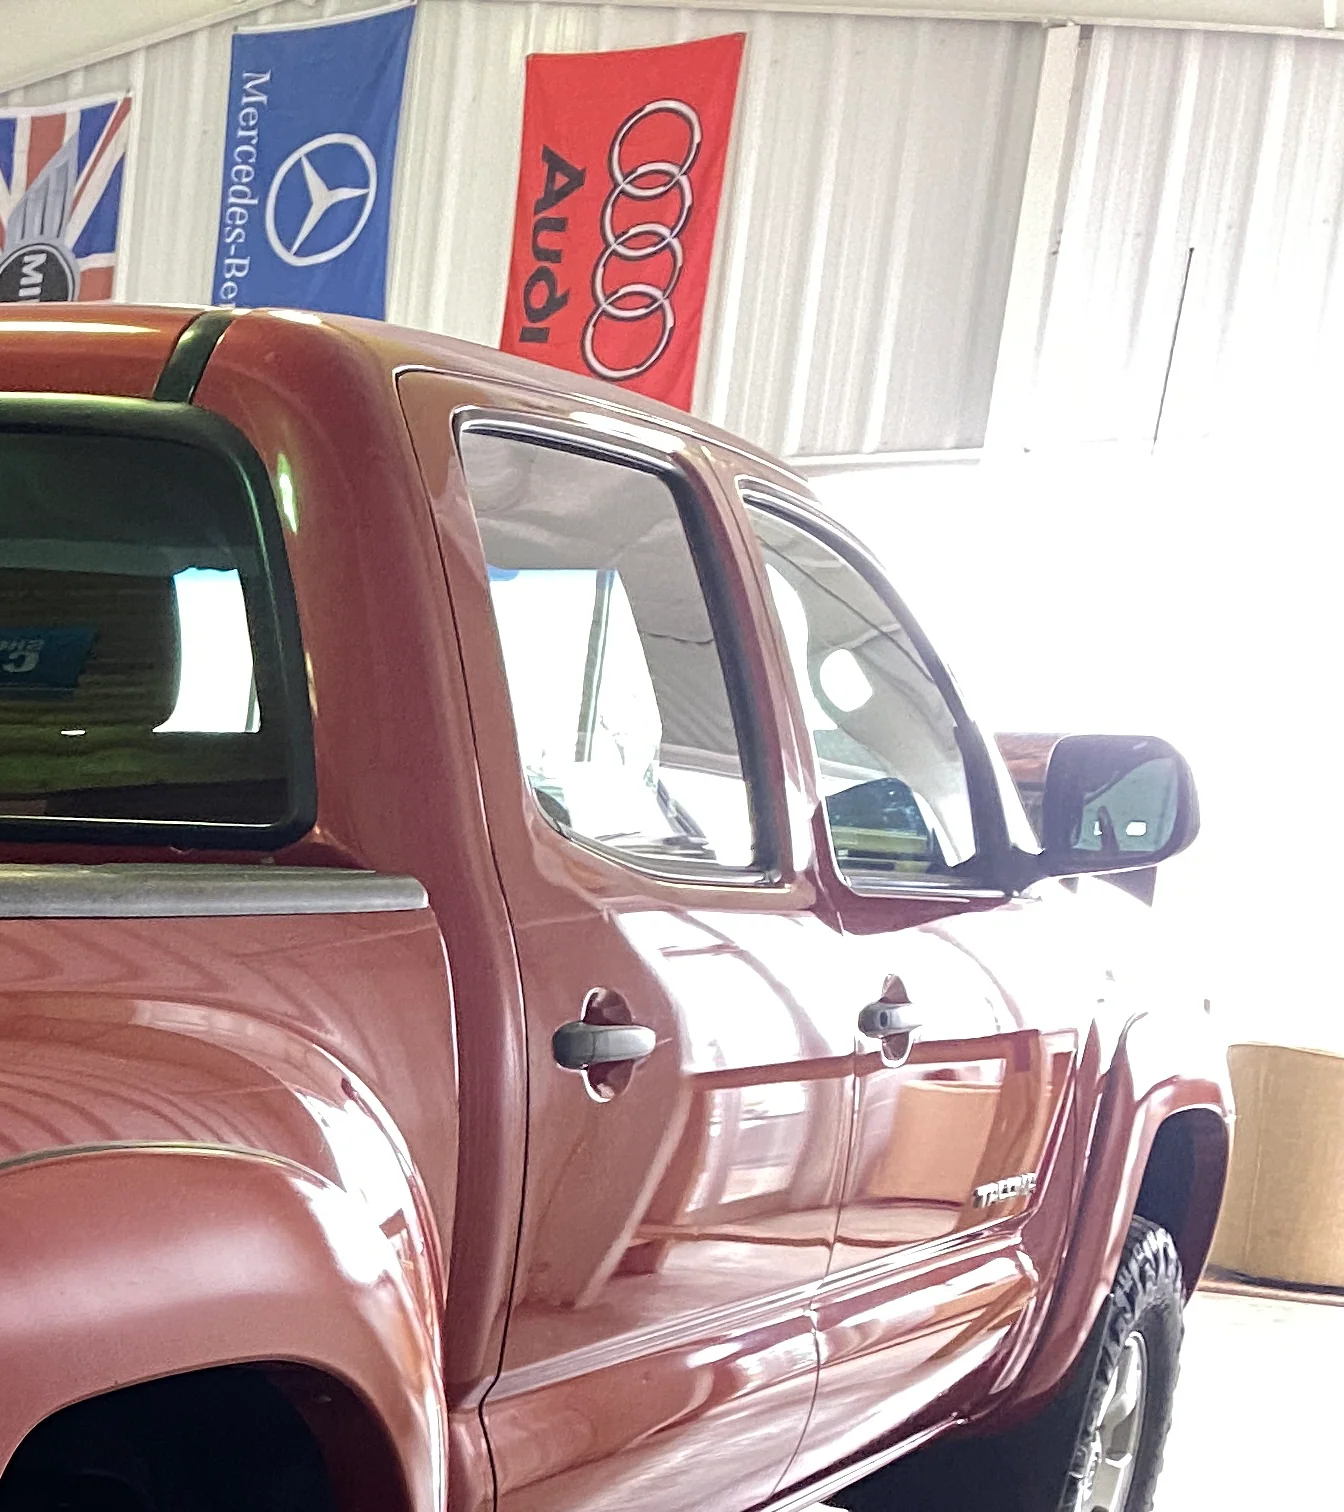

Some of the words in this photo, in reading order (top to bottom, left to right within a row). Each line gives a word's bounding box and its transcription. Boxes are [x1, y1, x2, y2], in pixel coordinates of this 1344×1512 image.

[18, 253, 47, 302] MI
[219, 69, 272, 309] Mercedes-Be
[519, 144, 586, 343] Audi
